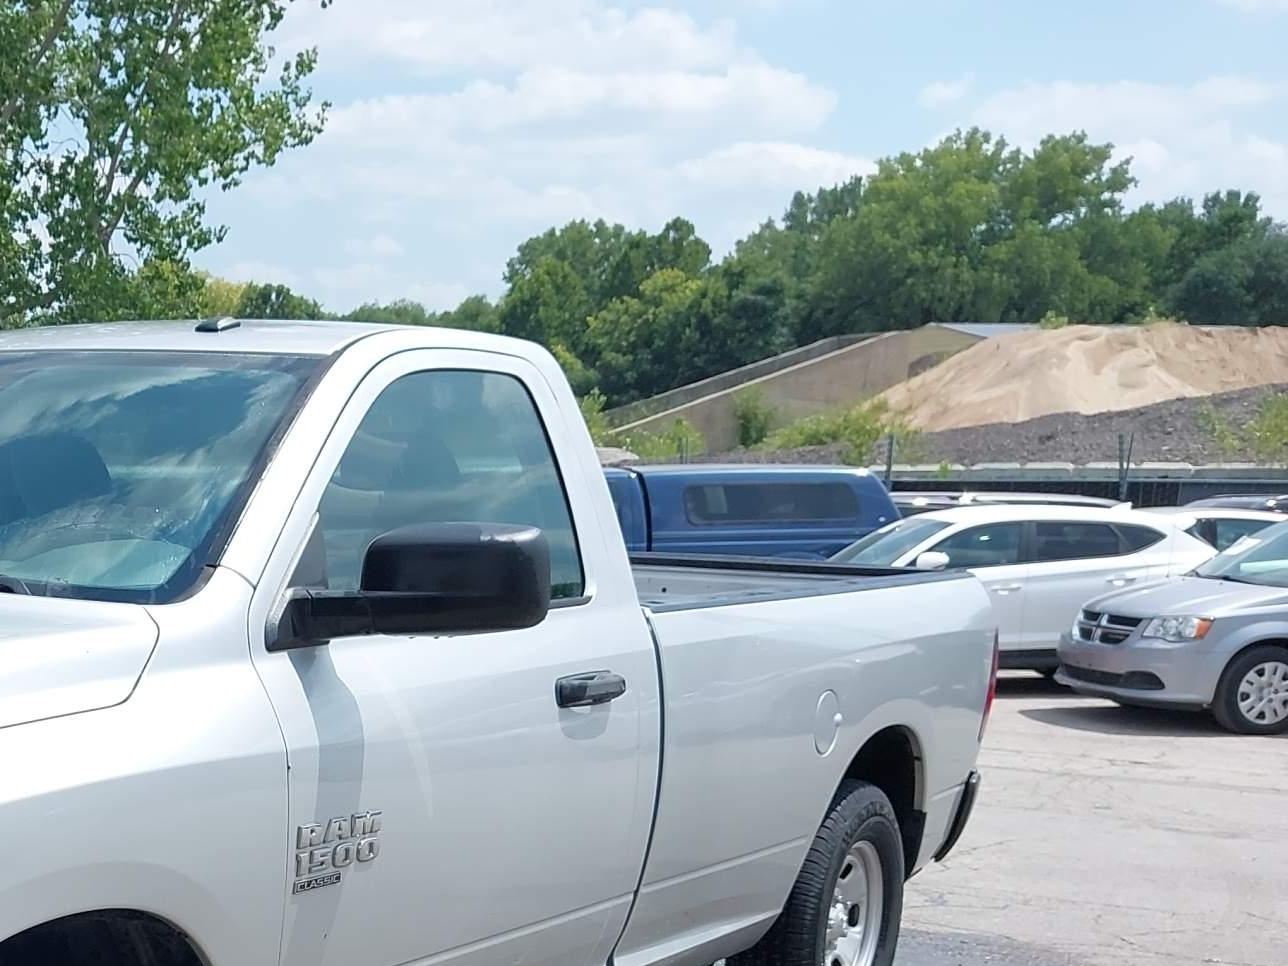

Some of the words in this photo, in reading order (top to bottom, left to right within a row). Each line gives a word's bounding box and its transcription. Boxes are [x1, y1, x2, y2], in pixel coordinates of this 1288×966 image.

[296, 810, 383, 850] RAM
[295, 837, 381, 877] 1500
[296, 873, 342, 892] CLASSIC
